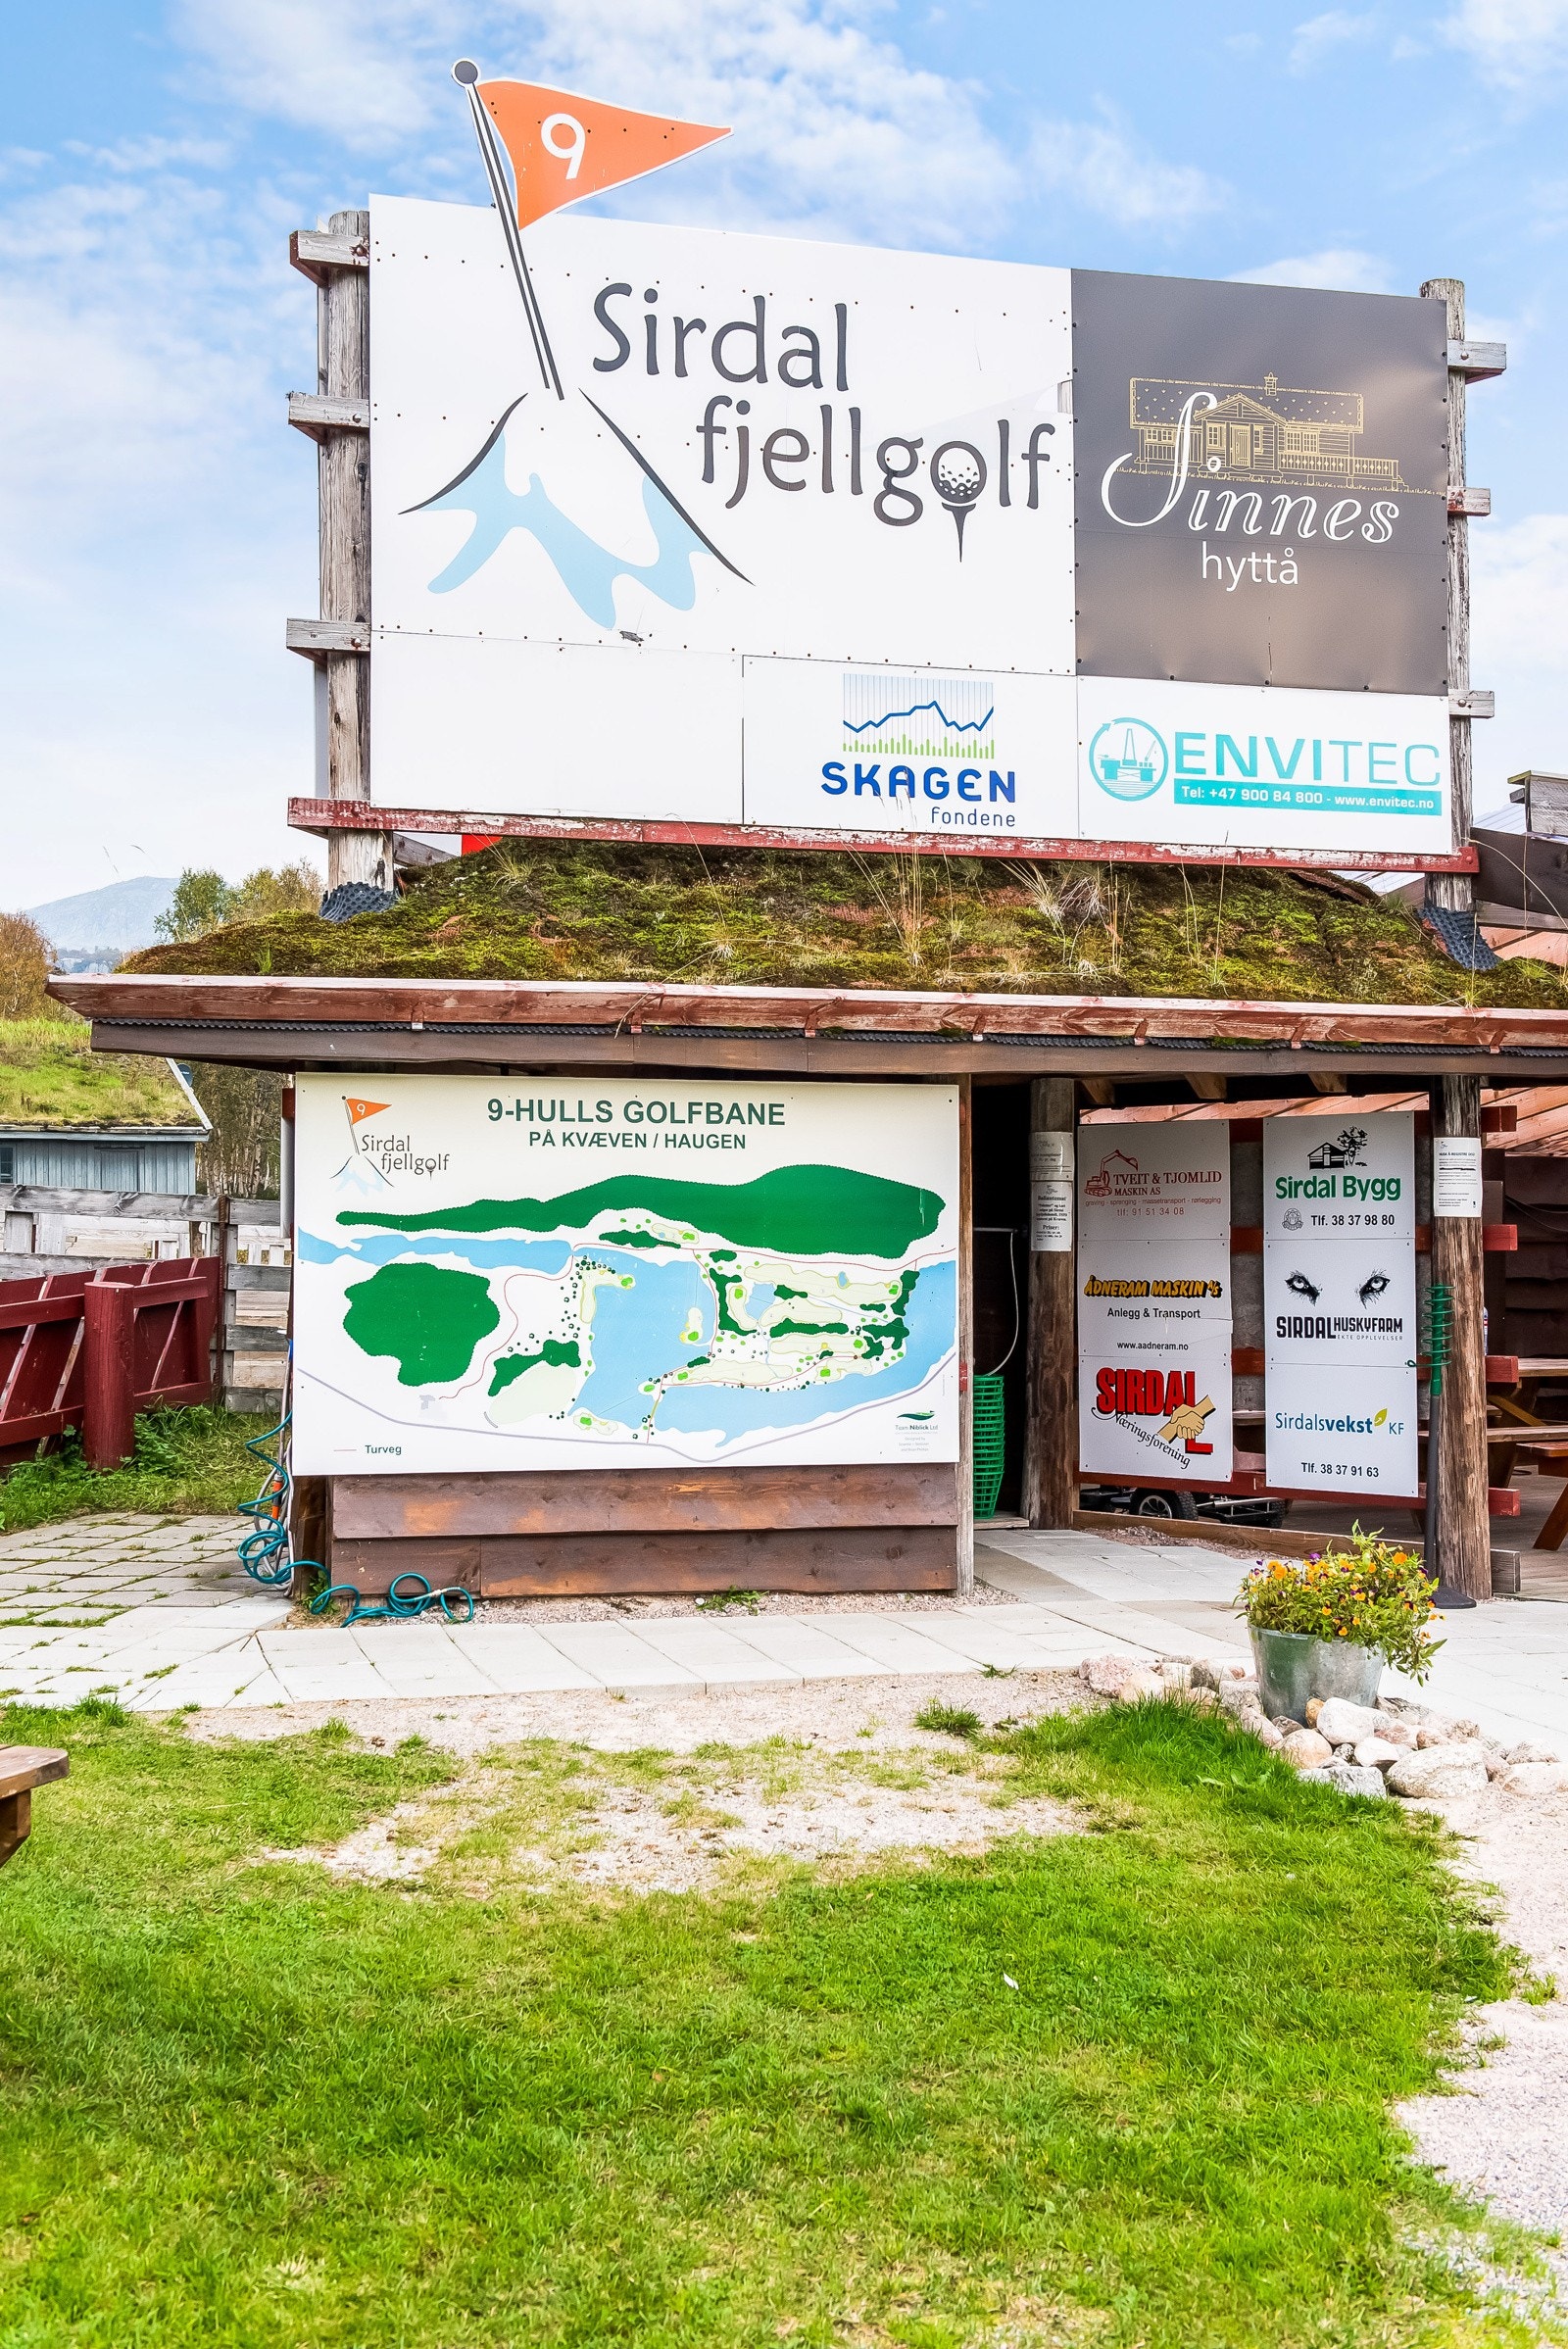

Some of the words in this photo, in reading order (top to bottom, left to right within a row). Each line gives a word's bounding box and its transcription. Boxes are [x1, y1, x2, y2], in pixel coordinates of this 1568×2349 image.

[541, 113, 586, 179] 9
[593, 282, 849, 391] Sirdal
[696, 395, 1055, 527] fjellgolf
[1101, 391, 1399, 543] Sinnes
[1201, 541, 1298, 592] hyttå
[1175, 731, 1441, 786] ENVITEC
[821, 761, 1015, 803] SKAGEN
[1181, 786, 1204, 799] Tel:
[1209, 788, 1236, 801] +47
[1242, 789, 1268, 802] 900
[1273, 791, 1291, 803] 84
[1296, 792, 1323, 805] 800
[1335, 795, 1435, 809] www.envitec.no
[931, 807, 1015, 827] fondene
[356, 1103, 367, 1116] 9
[487, 1099, 613, 1123] 9-HULLS
[623, 1101, 786, 1126] GOLFBANE
[362, 1135, 410, 1151] Sirdal
[529, 1129, 556, 1147] PÅ
[563, 1132, 647, 1148] KVÆVEN
[664, 1134, 746, 1150] HAUGEN
[381, 1153, 450, 1175] fjellgolf
[1113, 1173, 1149, 1185] TVEIT
[1152, 1174, 1160, 1185] &
[1163, 1171, 1222, 1185] TJOMLID
[1275, 1175, 1336, 1199] Sirdal
[1343, 1175, 1401, 1201] Bygg
[1311, 1215, 1328, 1226] Tlf.
[1332, 1215, 1345, 1226] 38
[1348, 1215, 1361, 1226] 37
[1364, 1215, 1378, 1226] 98
[1381, 1214, 1395, 1226] 80
[1084, 1275, 1150, 1298] ÅDNERAM
[1151, 1279, 1207, 1298] MASKIN
[1107, 1307, 1140, 1319] Anlegg
[1143, 1307, 1151, 1318] &
[1152, 1307, 1200, 1320] Transport
[1117, 1342, 1189, 1351] www.aadneram.no
[1097, 1367, 1213, 1455] SIRDAL
[1275, 1412, 1373, 1434] Sirdalsvekst
[1389, 1422, 1404, 1435] KF
[1091, 1407, 1191, 1469] Næringsforening
[365, 1444, 402, 1456] Turveg
[1301, 1462, 1317, 1473] Tlf.
[1320, 1463, 1333, 1474] 38
[1336, 1464, 1348, 1475] 37
[1350, 1465, 1362, 1477] 91
[1366, 1466, 1379, 1478] 63
